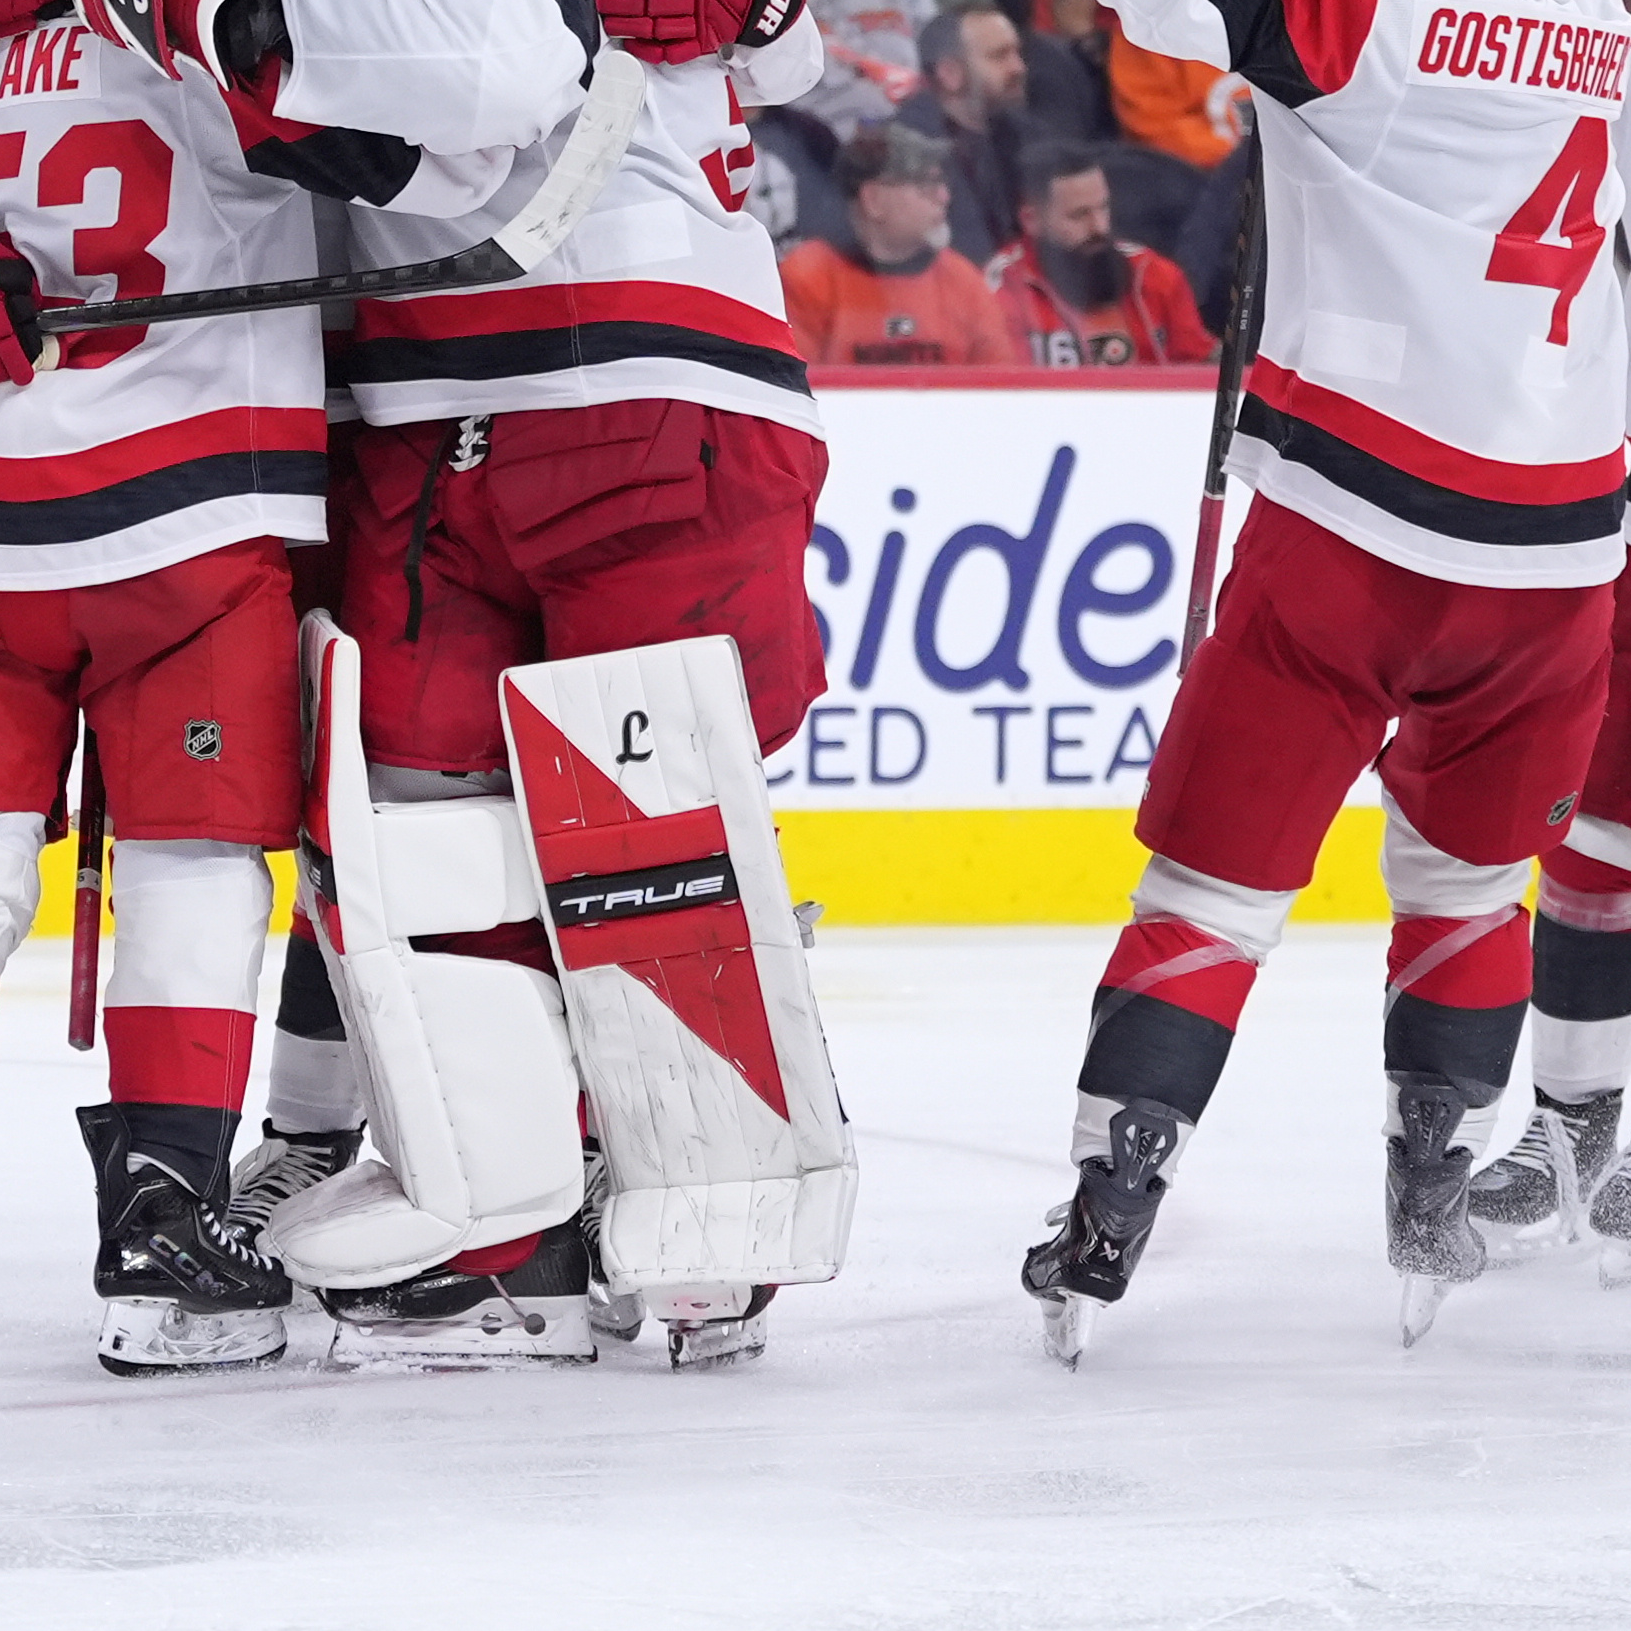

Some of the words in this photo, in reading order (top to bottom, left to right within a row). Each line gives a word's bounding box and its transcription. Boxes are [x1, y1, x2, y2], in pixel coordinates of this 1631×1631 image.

[1484, 115, 1608, 347] 4
[191, 730, 214, 751] NHL
[560, 874, 726, 917] TRUE
